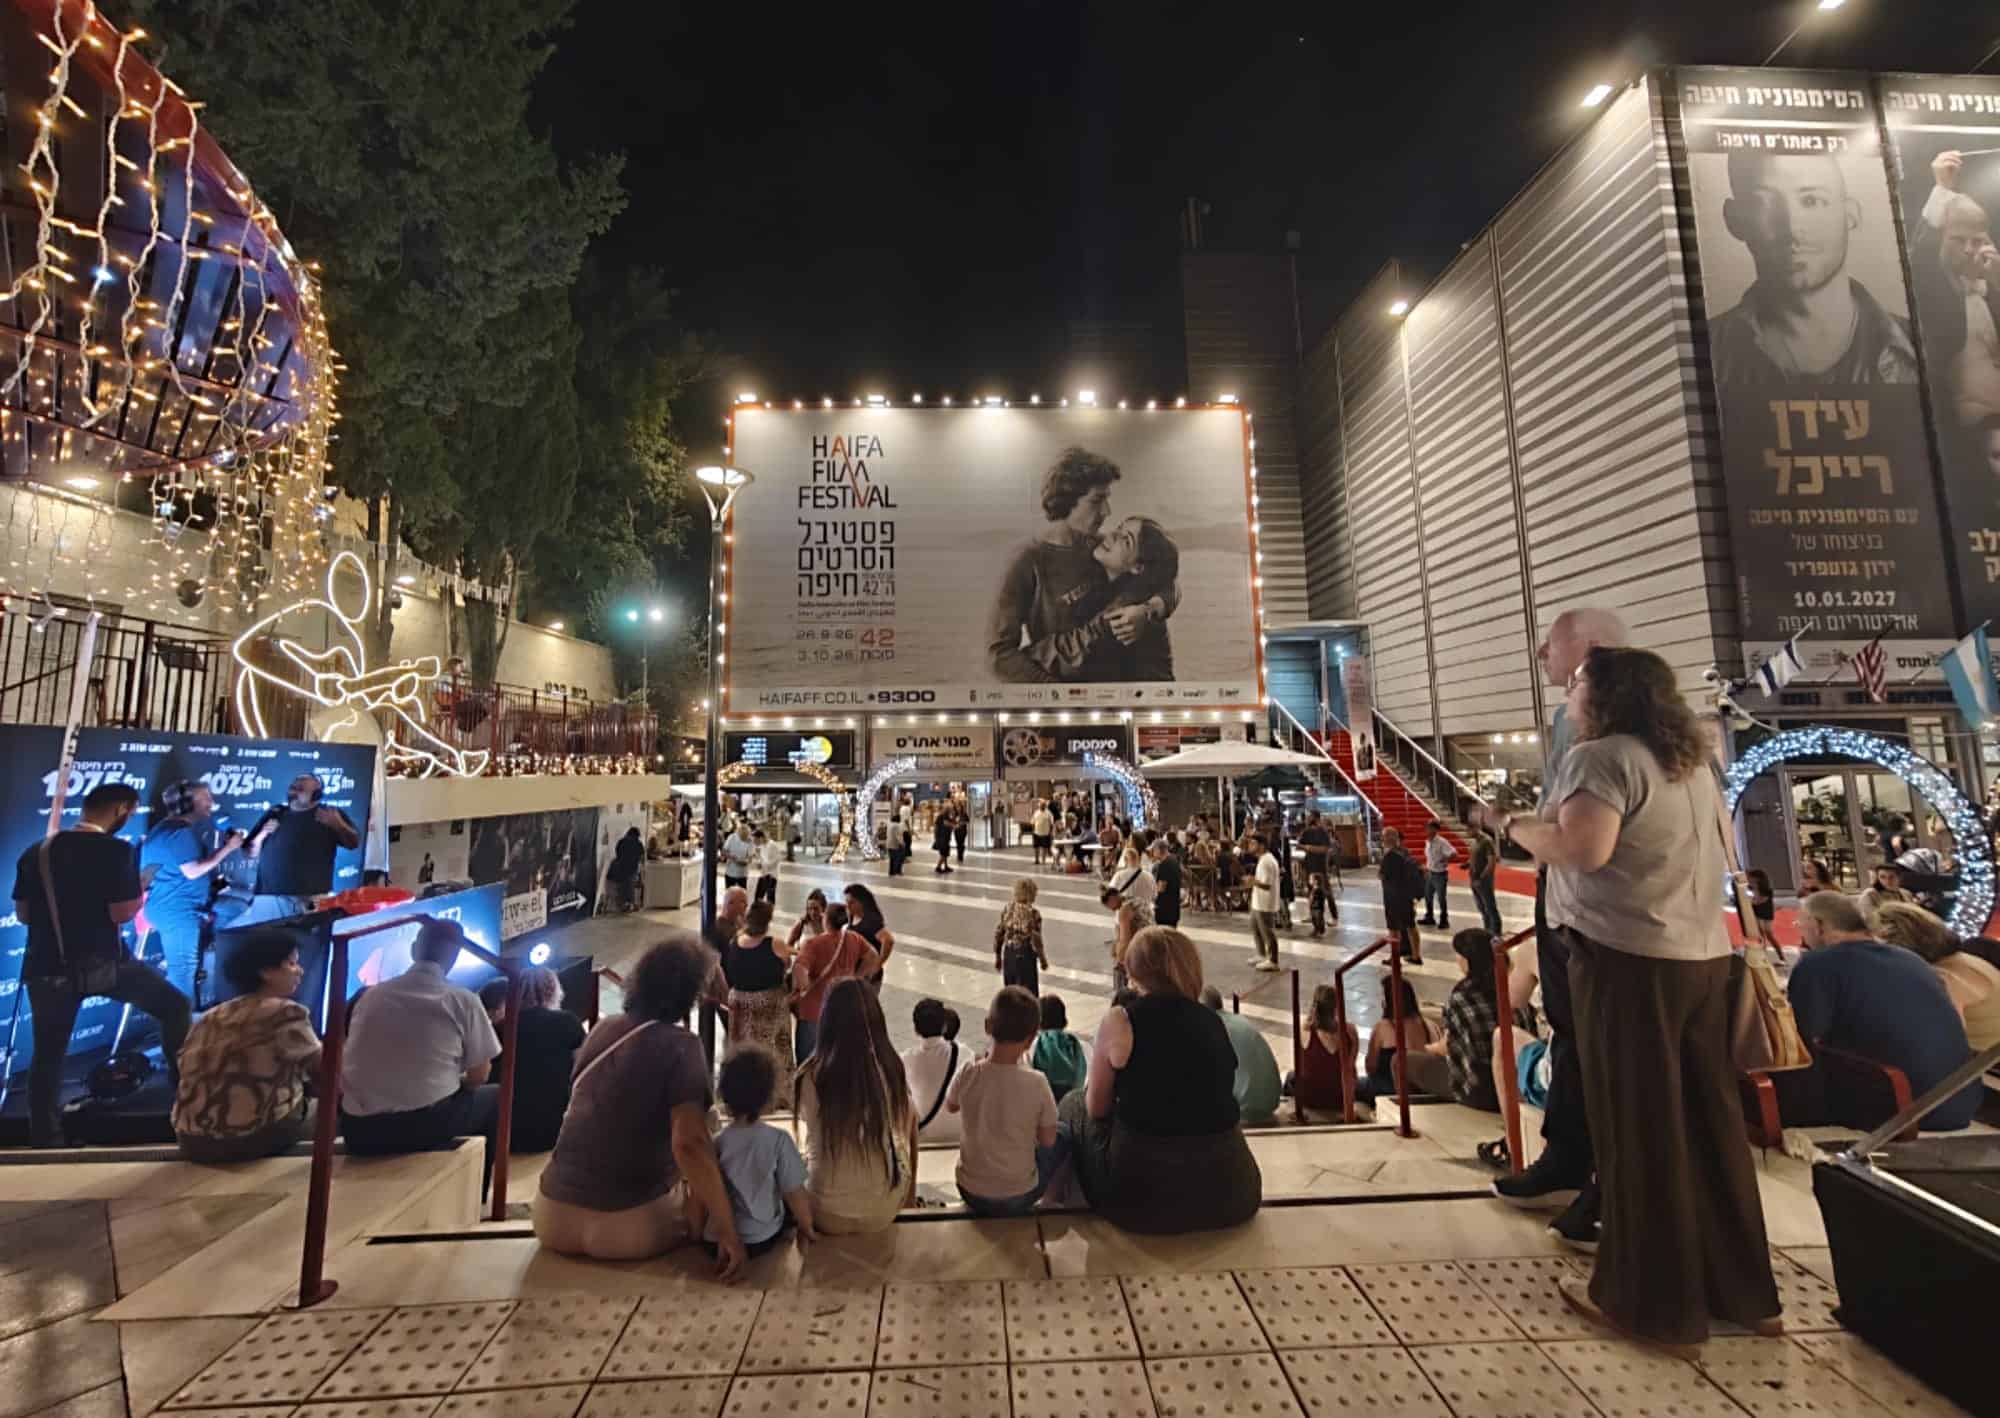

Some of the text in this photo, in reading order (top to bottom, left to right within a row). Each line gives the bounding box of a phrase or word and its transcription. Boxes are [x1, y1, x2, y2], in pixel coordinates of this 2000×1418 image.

[1685, 85, 1865, 109] הסימפונית חיפה
[1887, 91, 1944, 112] חיפה
[1716, 131, 1761, 148] חיפה!
[1827, 135, 1849, 152] רק
[1769, 399, 1871, 450] עידן
[812, 433, 884, 458] HAIFA
[812, 459, 870, 483] FILM
[1763, 449, 1894, 496] רייכל
[798, 484, 897, 509] FESTIVAL
[1797, 508, 1890, 526] הסימפונית
[797, 517, 895, 546] פסטיבל
[1791, 533, 1884, 552] בניצוחו של
[797, 546, 895, 571] הסרטים
[1863, 559, 1897, 580] ירון
[797, 572, 858, 598] חיפה
[1793, 590, 1897, 607] 10.01.2027
[861, 628, 895, 648] 42
[759, 691, 864, 705] HAIFAFF.CO.IL
